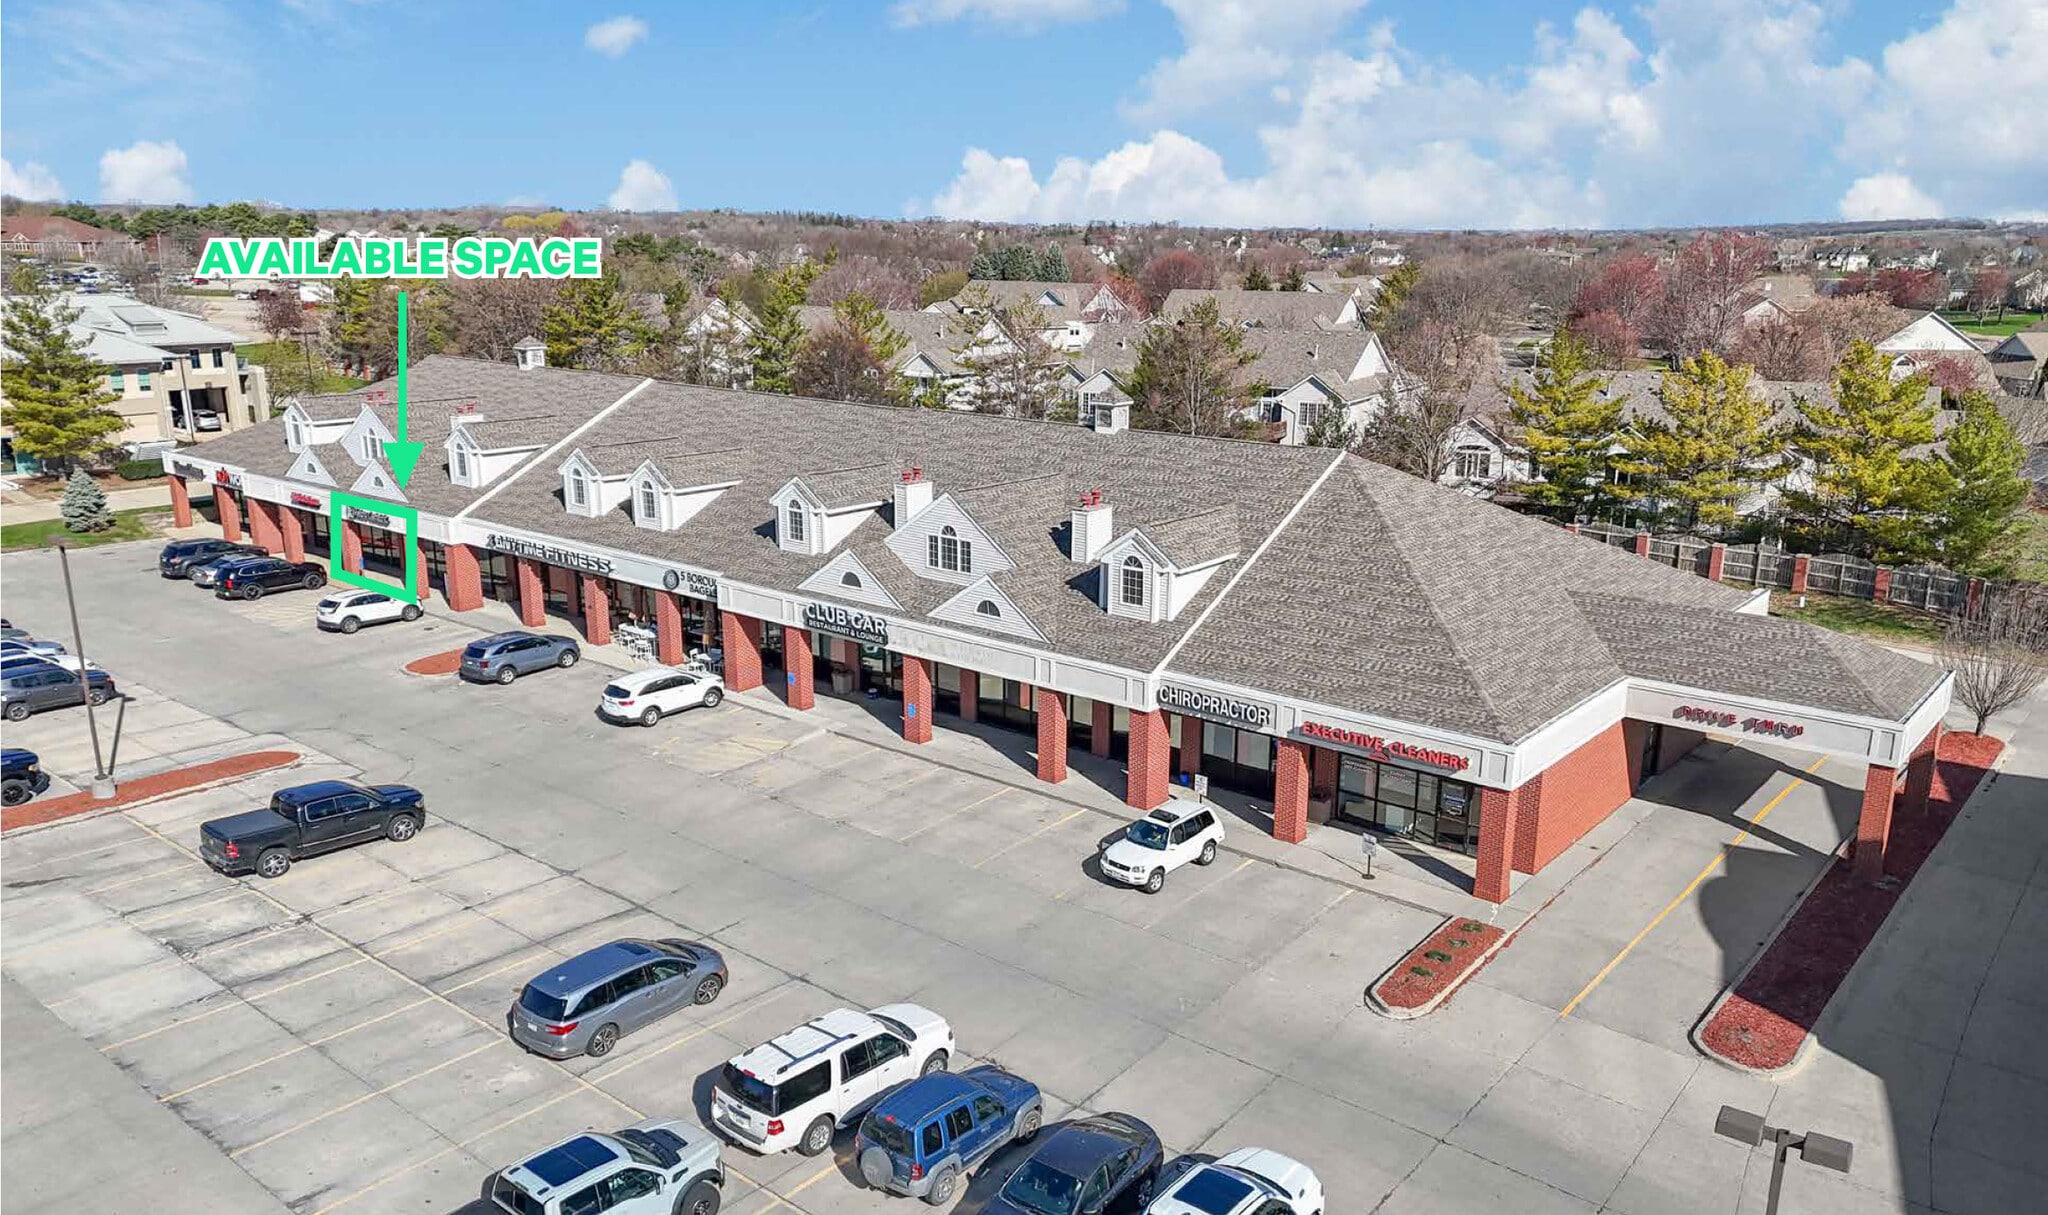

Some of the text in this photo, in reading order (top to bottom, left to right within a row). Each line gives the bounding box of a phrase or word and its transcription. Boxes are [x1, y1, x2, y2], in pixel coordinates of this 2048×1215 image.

[545, 545, 613, 574] FITNESS
[680, 571, 686, 581] 5
[805, 603, 886, 635] CLUB CAR
[808, 619, 850, 635] RESTAURANT
[856, 631, 884, 644] LOUNGE
[1159, 685, 1269, 725] CHIROPRACTOR
[1303, 720, 1385, 751] EXECUTIVE
[1388, 741, 1470, 770] CLEANERS
